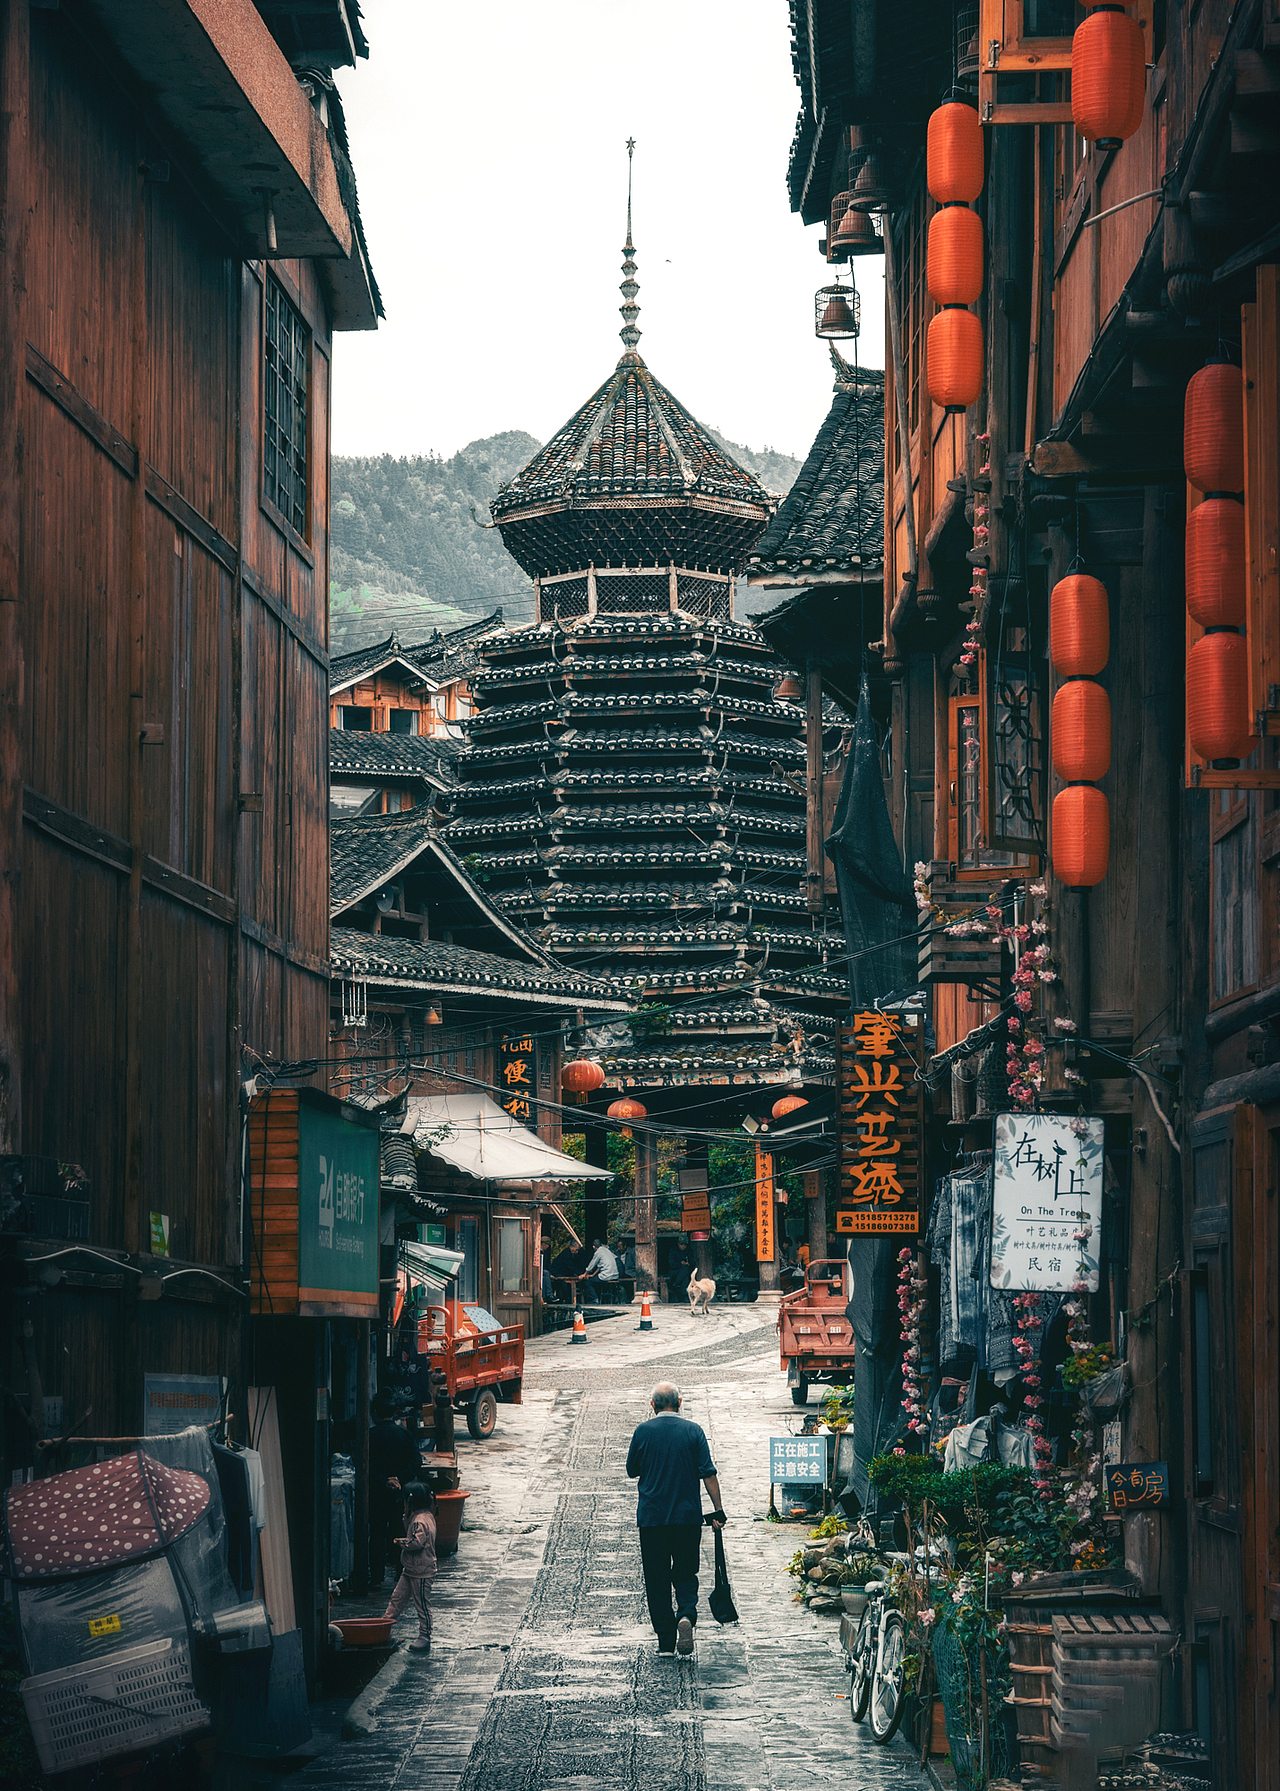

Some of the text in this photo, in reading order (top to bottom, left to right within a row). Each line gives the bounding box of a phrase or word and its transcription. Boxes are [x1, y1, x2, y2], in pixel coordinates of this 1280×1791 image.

[849, 1010, 904, 1206] 肇兴艺绣
[1007, 1131, 1091, 1202] 在树上
[319, 1155, 335, 1249] 24
[336, 1170, 365, 1225] 自助银行
[855, 1213, 916, 1221] 15185713278
[1020, 1205, 1033, 1215] On
[1038, 1206, 1054, 1216] The
[855, 1222, 916, 1231] 15186907388
[1028, 1256, 1062, 1272] 民宿
[773, 1442, 821, 1458] 正在施工
[773, 1461, 821, 1477] 注意安全
